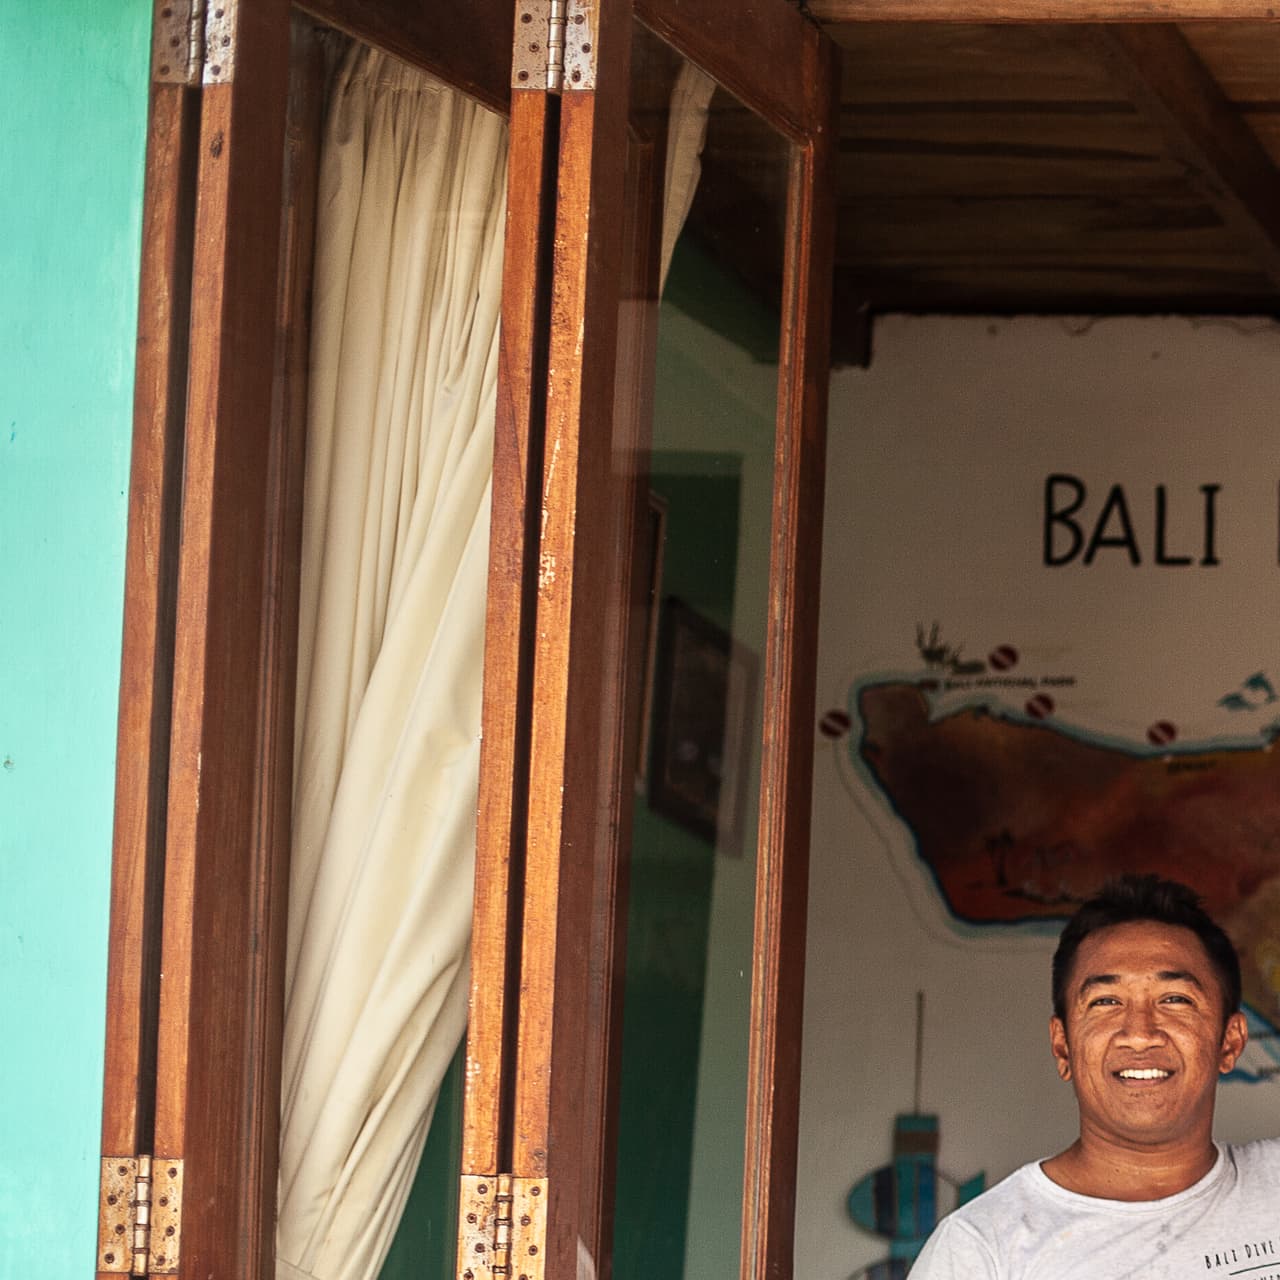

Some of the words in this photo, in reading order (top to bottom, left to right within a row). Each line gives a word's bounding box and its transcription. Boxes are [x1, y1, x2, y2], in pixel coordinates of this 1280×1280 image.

[1043, 473, 1223, 567] BALI
[1204, 1248, 1238, 1270] BALI
[1244, 1239, 1275, 1259] DIVE
